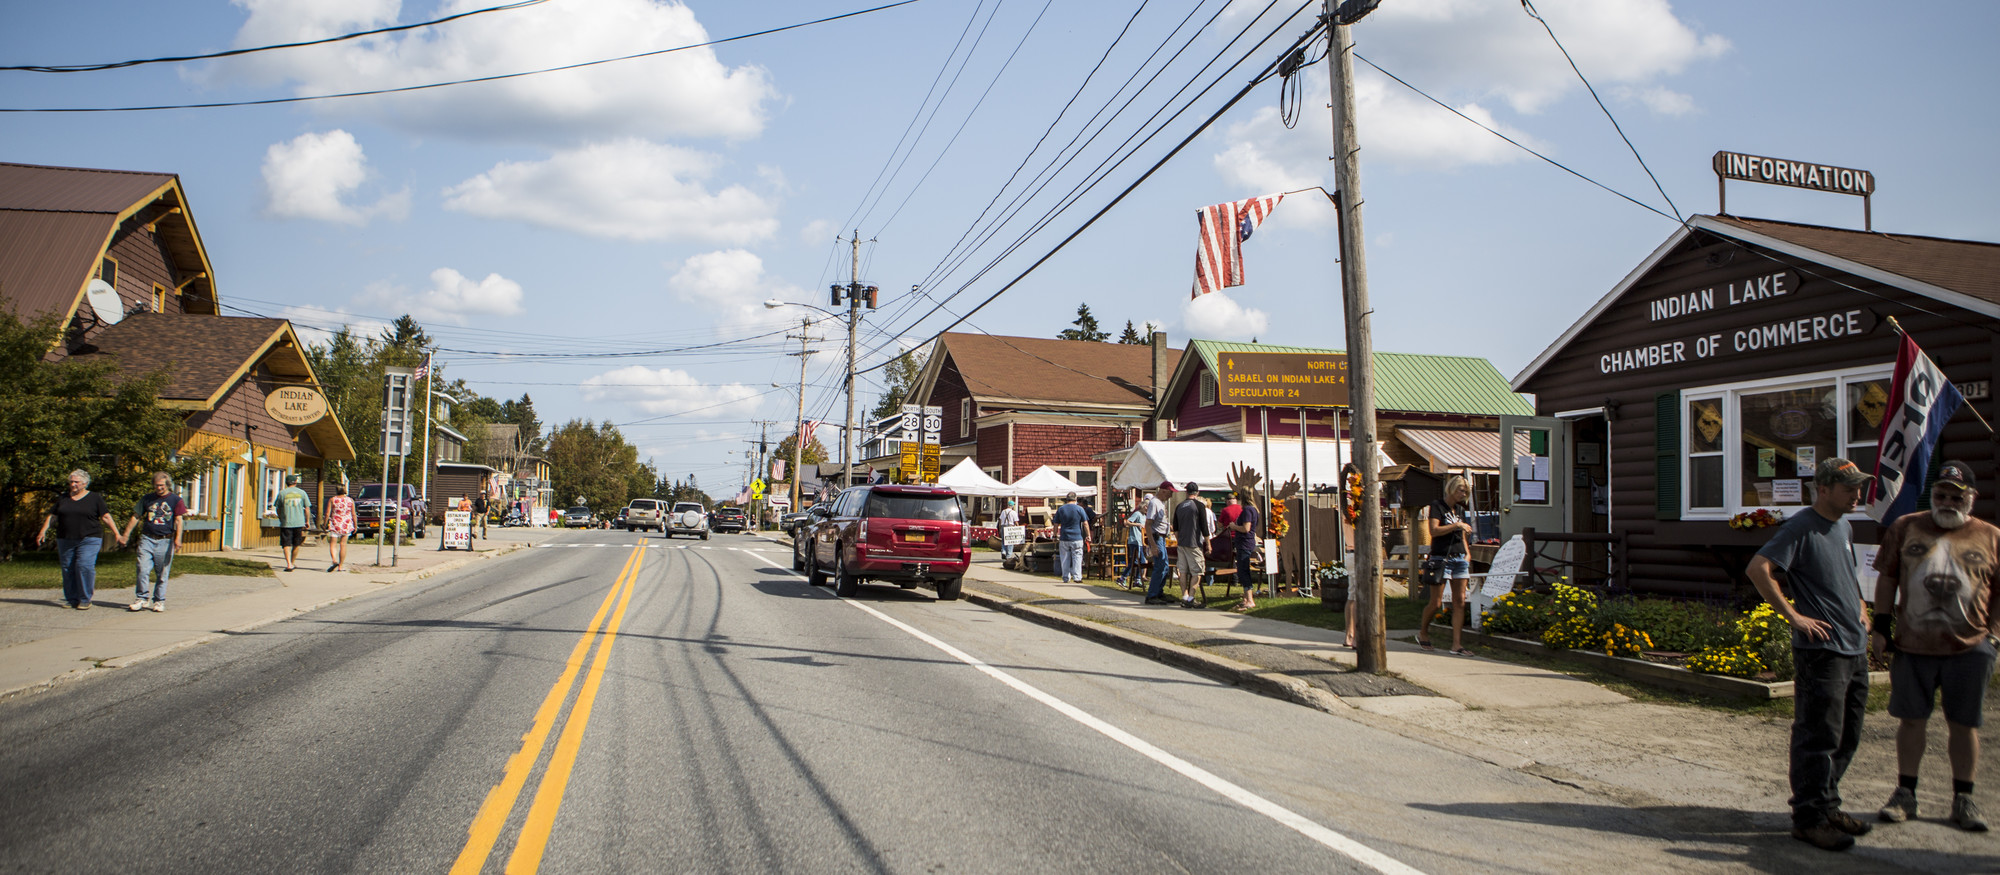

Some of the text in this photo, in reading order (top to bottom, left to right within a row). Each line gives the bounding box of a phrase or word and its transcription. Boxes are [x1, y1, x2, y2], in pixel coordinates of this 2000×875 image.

[1726, 153, 1868, 193] INFORMATION
[1651, 272, 1787, 322] INDIAN LAKE
[1600, 309, 1862, 374] CHAMBER OF COMMERCE
[1307, 361, 1336, 370] NORTH
[1227, 374, 1345, 384] SABAEL ON INDIAN LAKE 4
[280, 390, 314, 400] INDIAN
[1228, 388, 1300, 398] SPECULATOR 24
[284, 402, 309, 411] LAKE
[903, 417, 918, 427] 28
[925, 419, 940, 428] 30
